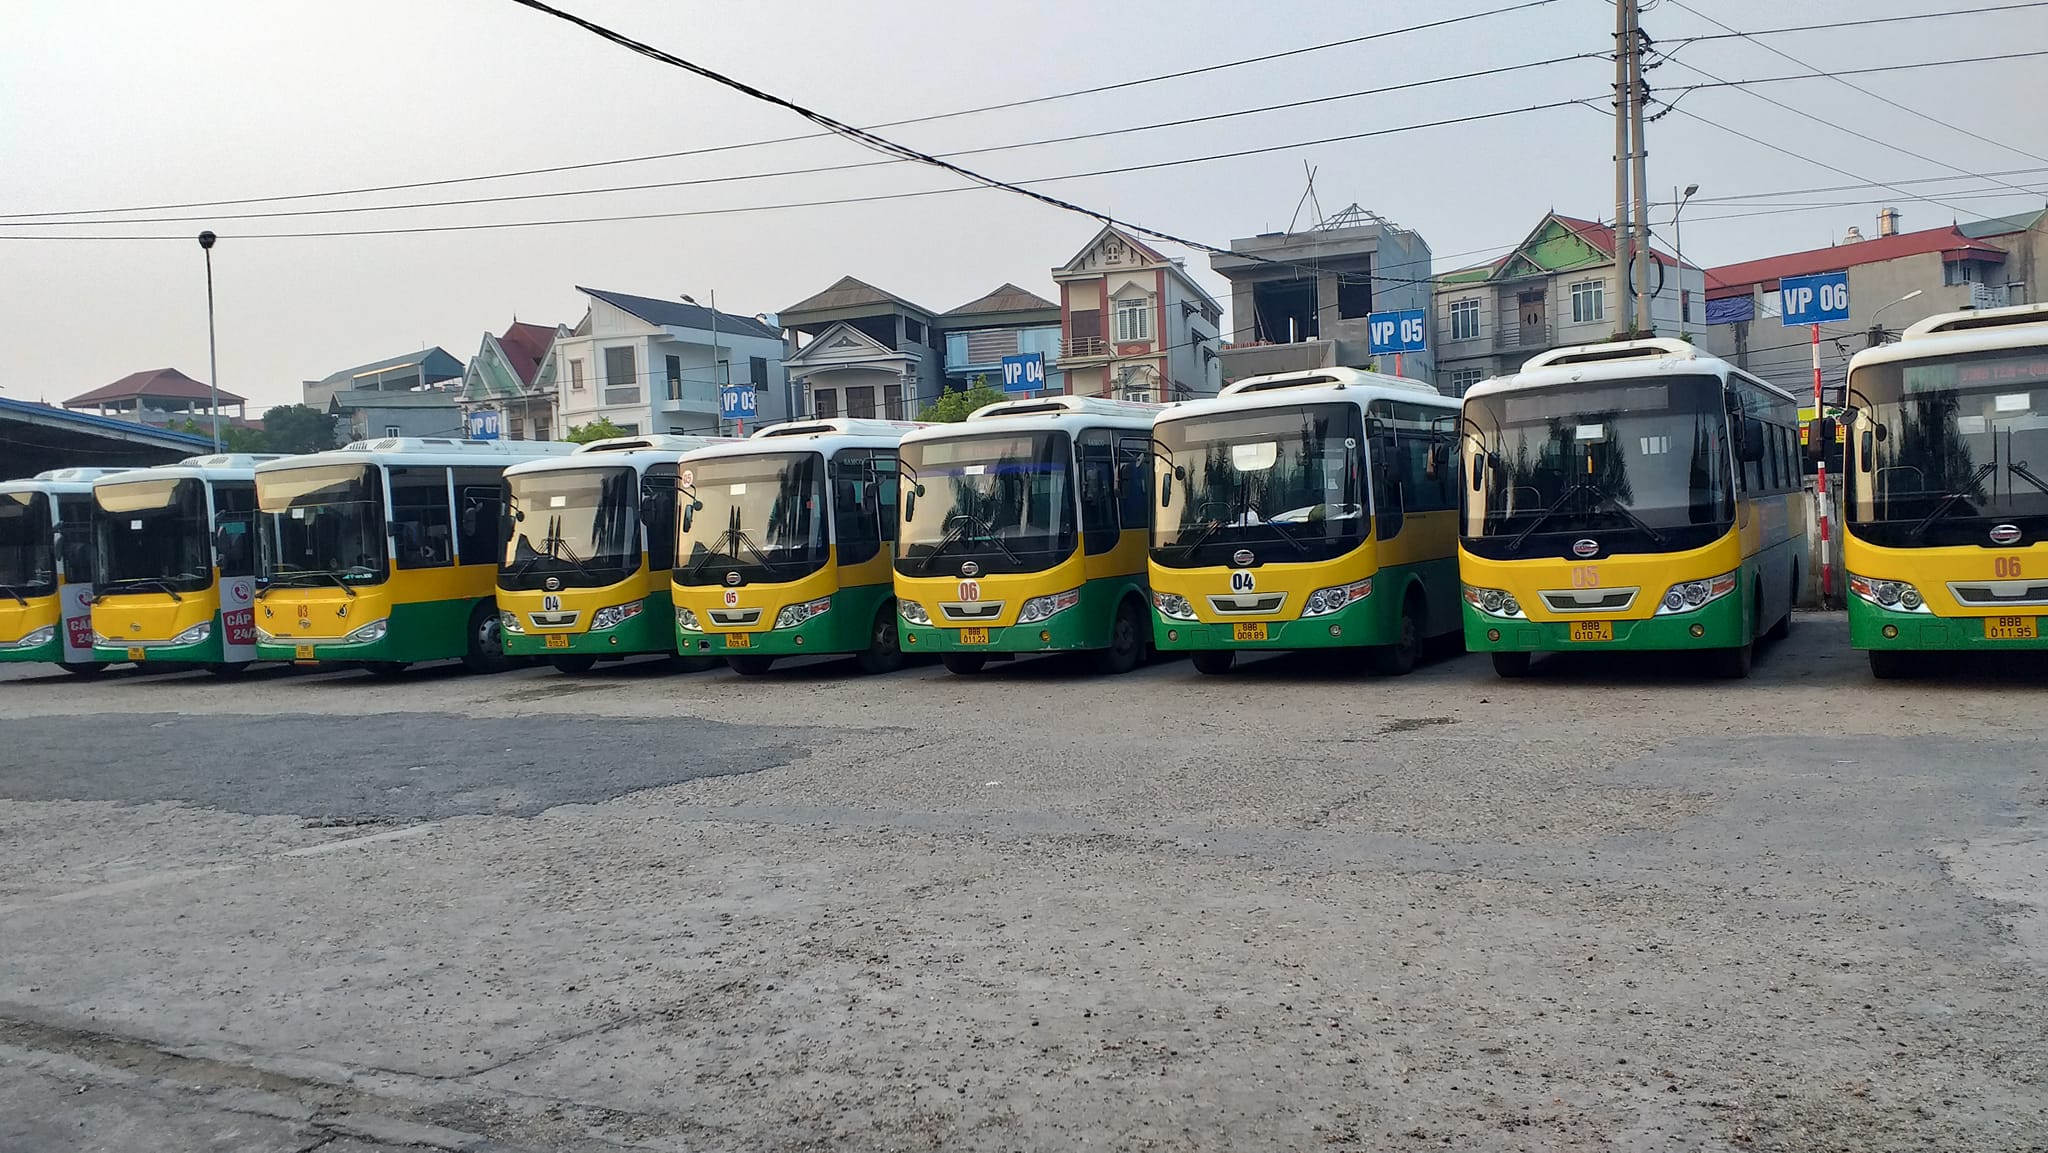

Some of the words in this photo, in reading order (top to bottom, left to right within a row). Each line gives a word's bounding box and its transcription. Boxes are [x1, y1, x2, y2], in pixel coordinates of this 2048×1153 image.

[1784, 287, 1812, 315] VP
[1820, 284, 1847, 311] 06
[1370, 322, 1395, 345] VP
[1400, 319, 1423, 343] 05
[1004, 362, 1018, 384] VP
[1026, 361, 1043, 383] 04
[723, 392, 738, 411] VP
[741, 391, 755, 410] 03
[471, 418, 483, 435] VP
[485, 416, 497, 433] 07
[1995, 556, 2022, 577] 06
[1232, 573, 1254, 590] 04
[1571, 565, 1600, 588] 05
[726, 592, 736, 604] 05
[960, 582, 978, 601] 06
[297, 604, 308, 617] 03
[545, 596, 559, 610] 04
[1242, 623, 1258, 631] 88B
[1581, 621, 1600, 630] 88B
[1999, 617, 2021, 627] 88B
[1990, 627, 2032, 638] 011.95
